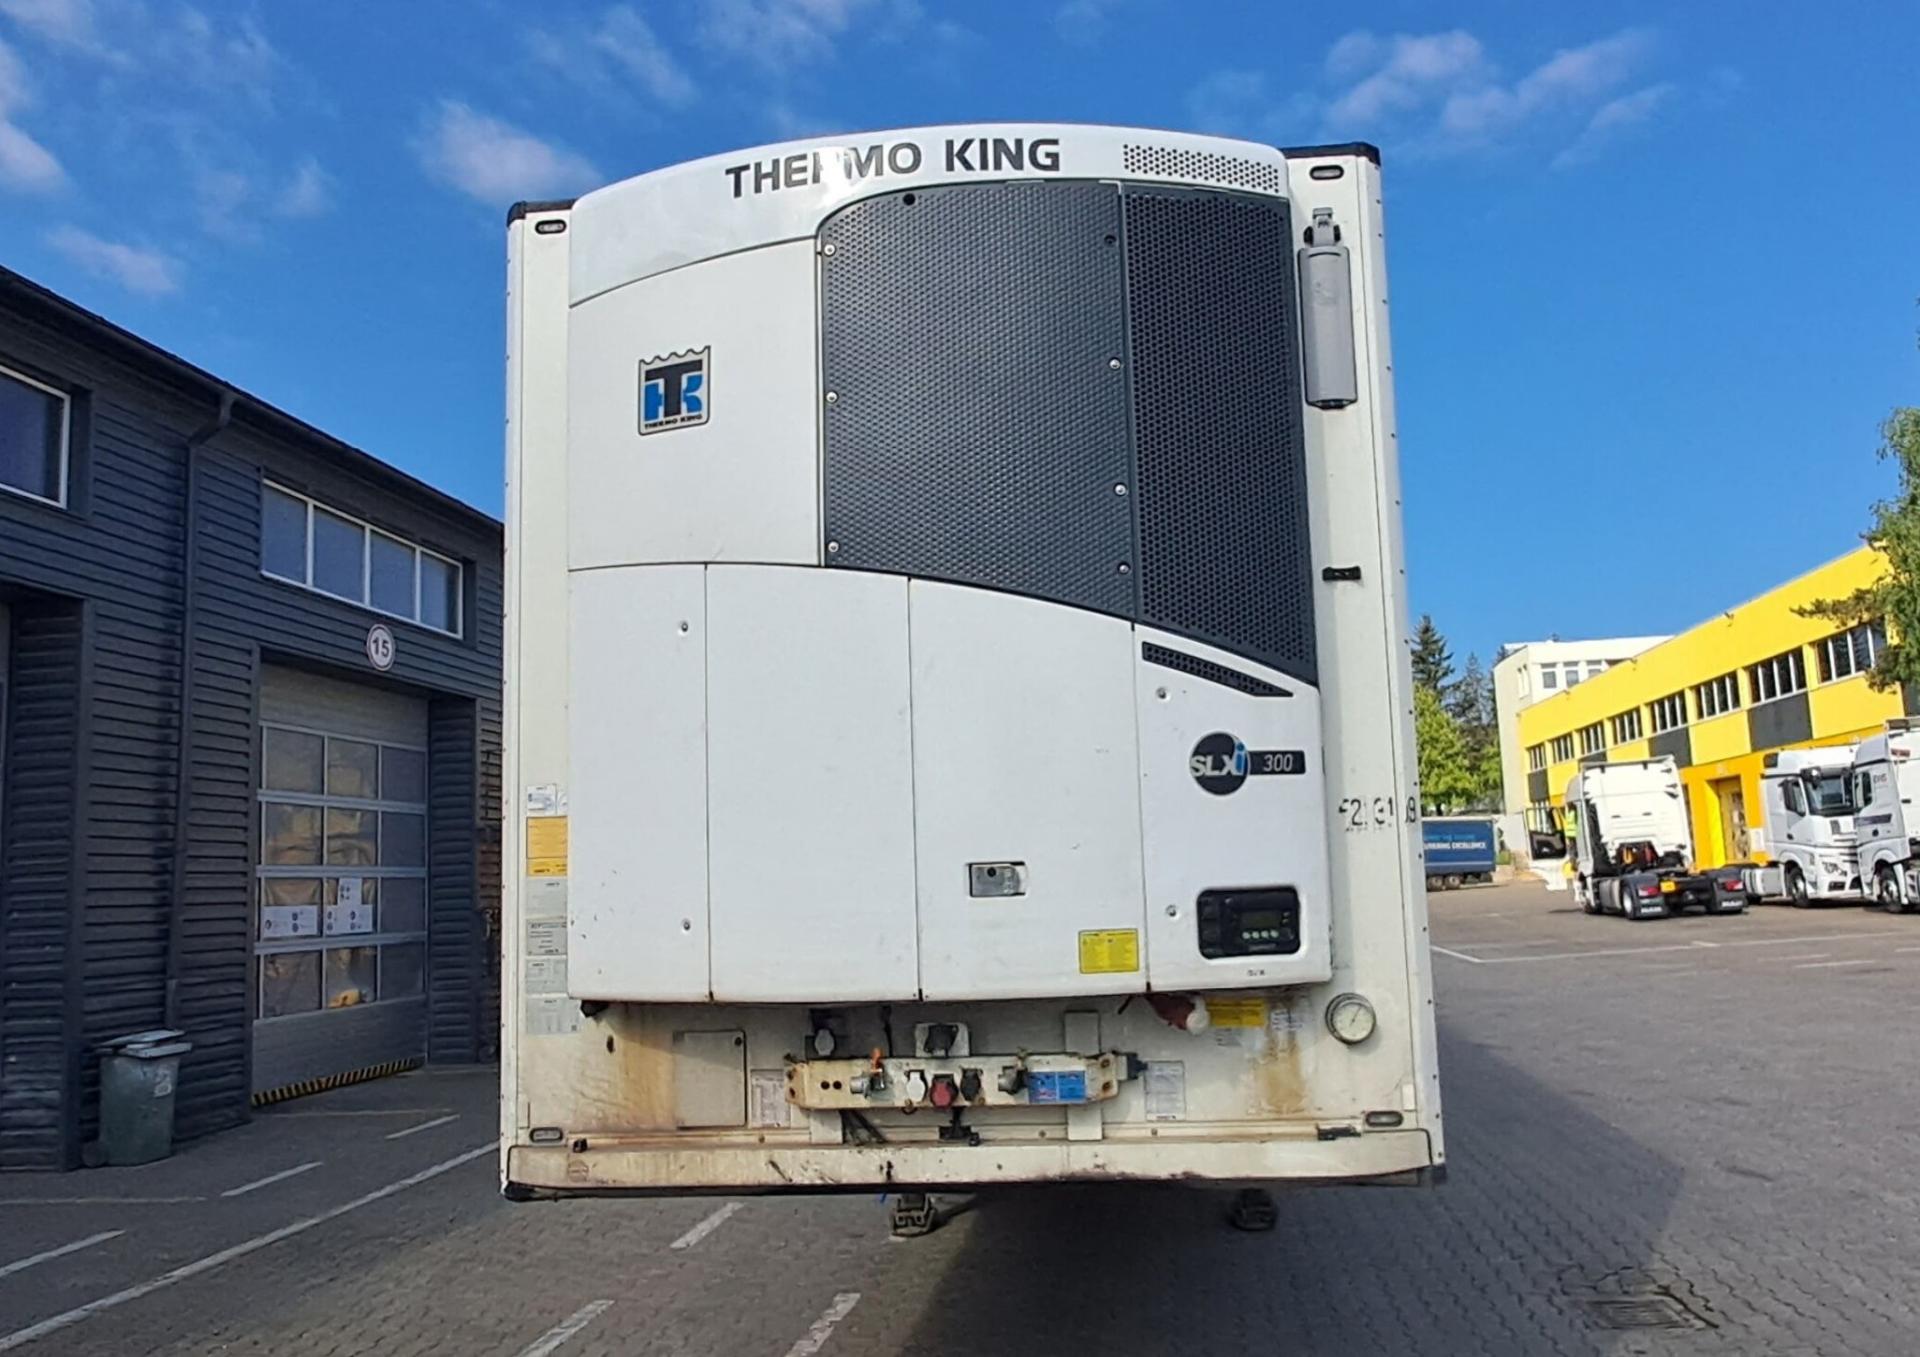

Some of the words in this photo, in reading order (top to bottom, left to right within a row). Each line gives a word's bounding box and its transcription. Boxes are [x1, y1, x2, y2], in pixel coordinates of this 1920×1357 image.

[945, 138, 1060, 172] KING
[372, 636, 390, 658] 15
[1263, 753, 1294, 772] 300
